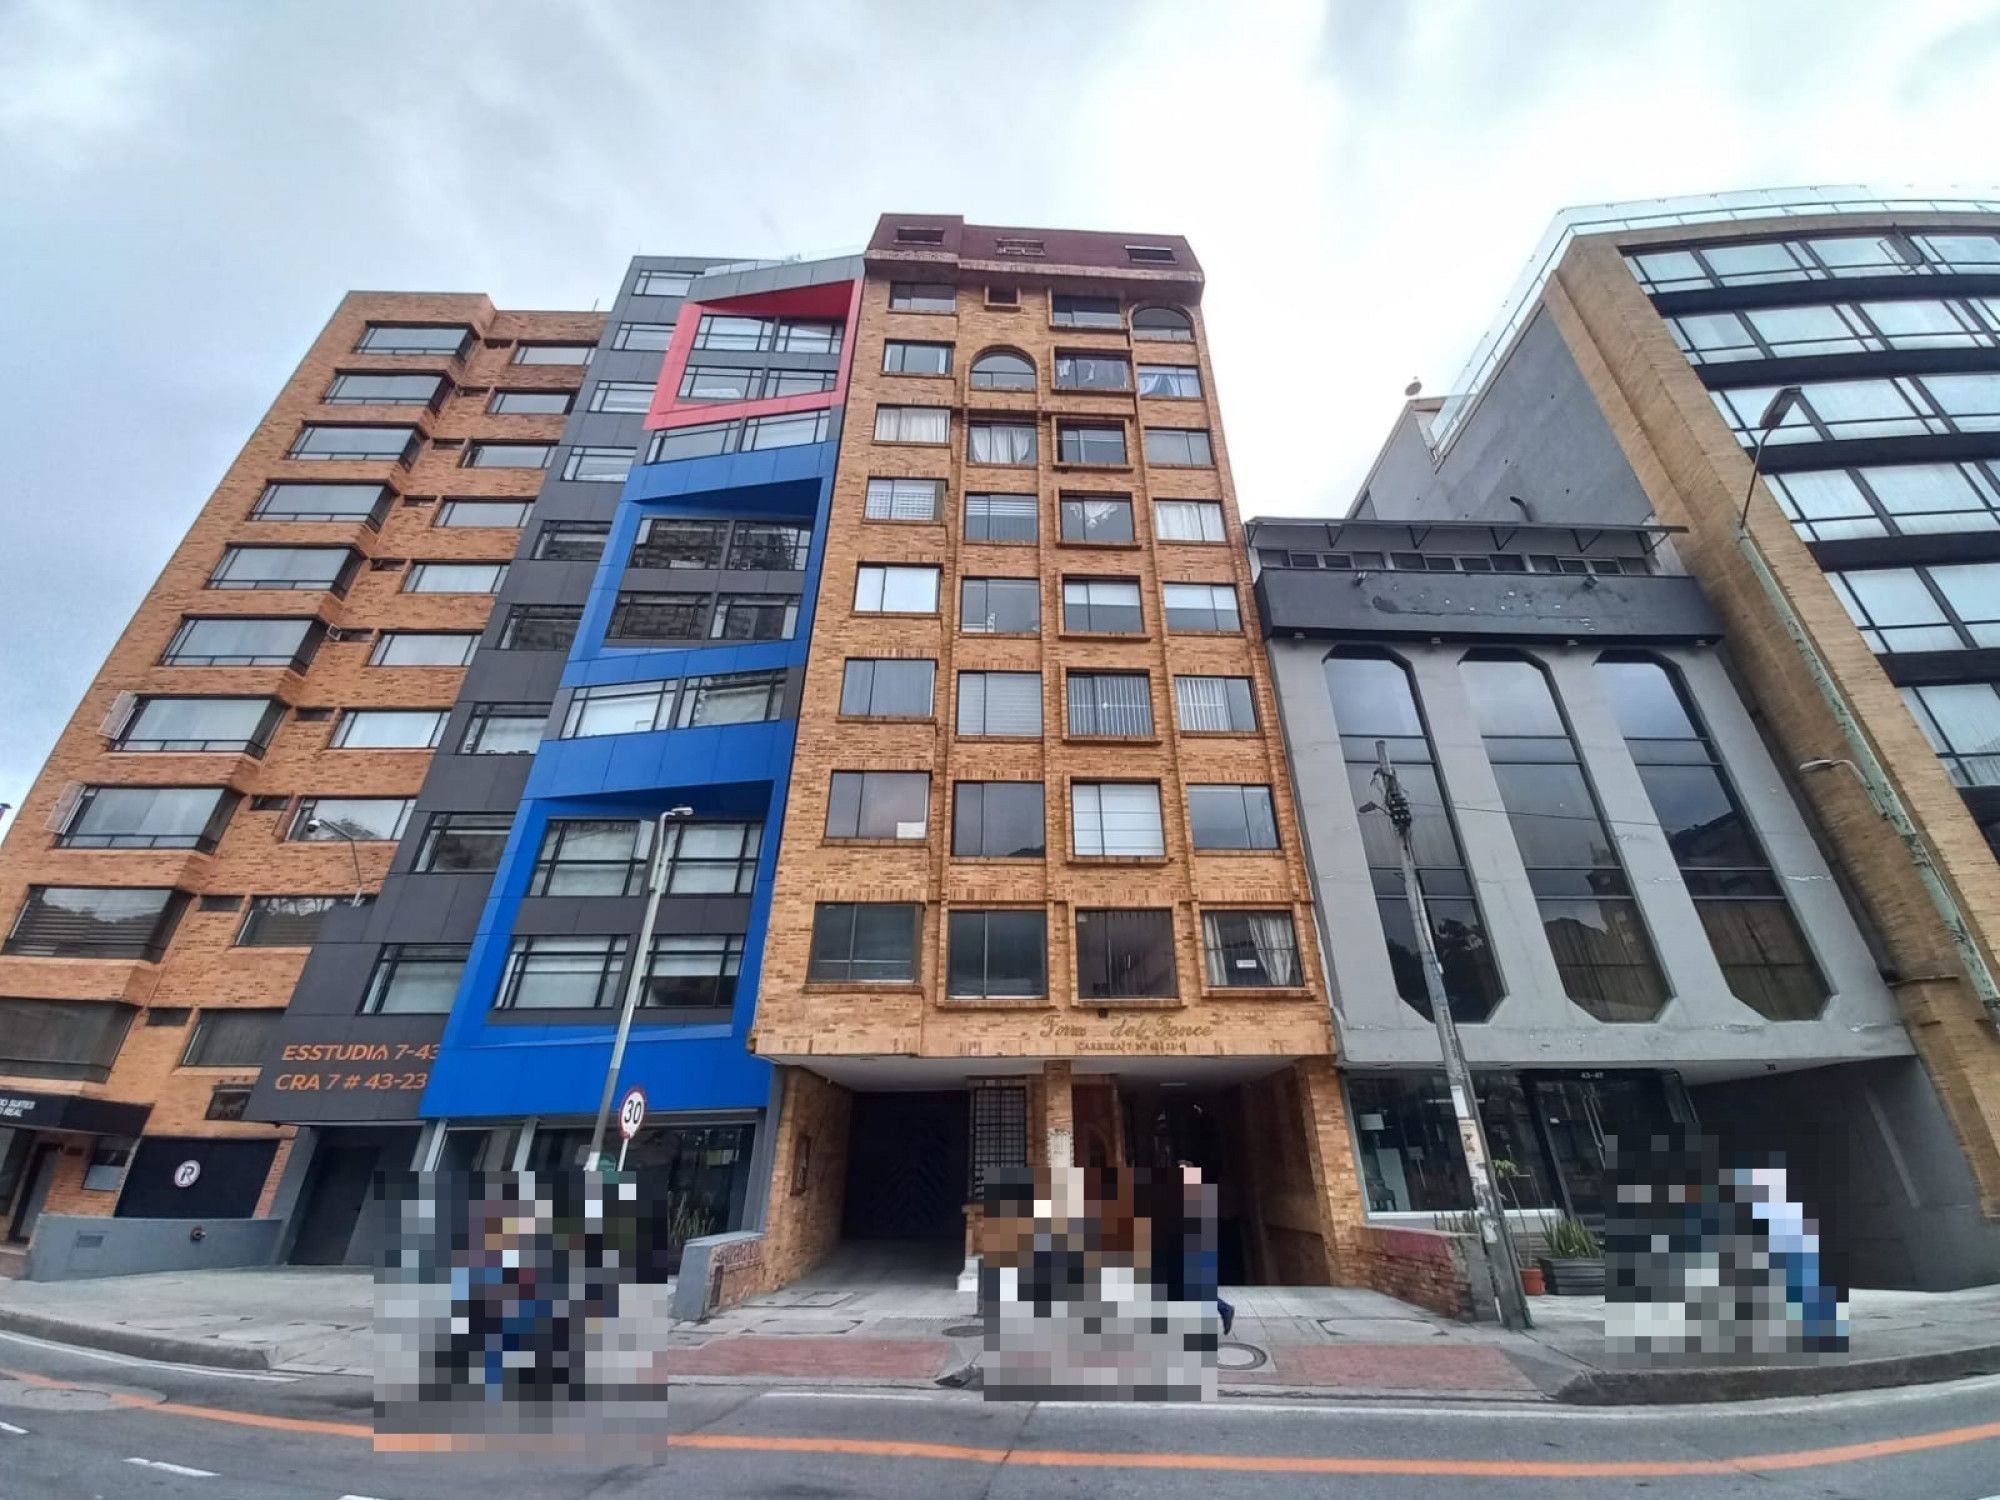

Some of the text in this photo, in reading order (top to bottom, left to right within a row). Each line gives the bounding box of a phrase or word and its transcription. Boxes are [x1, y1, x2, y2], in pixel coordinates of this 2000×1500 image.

[274, 1073, 428, 1090] CRA 7 # 43-23
[624, 1099, 642, 1125] 30
